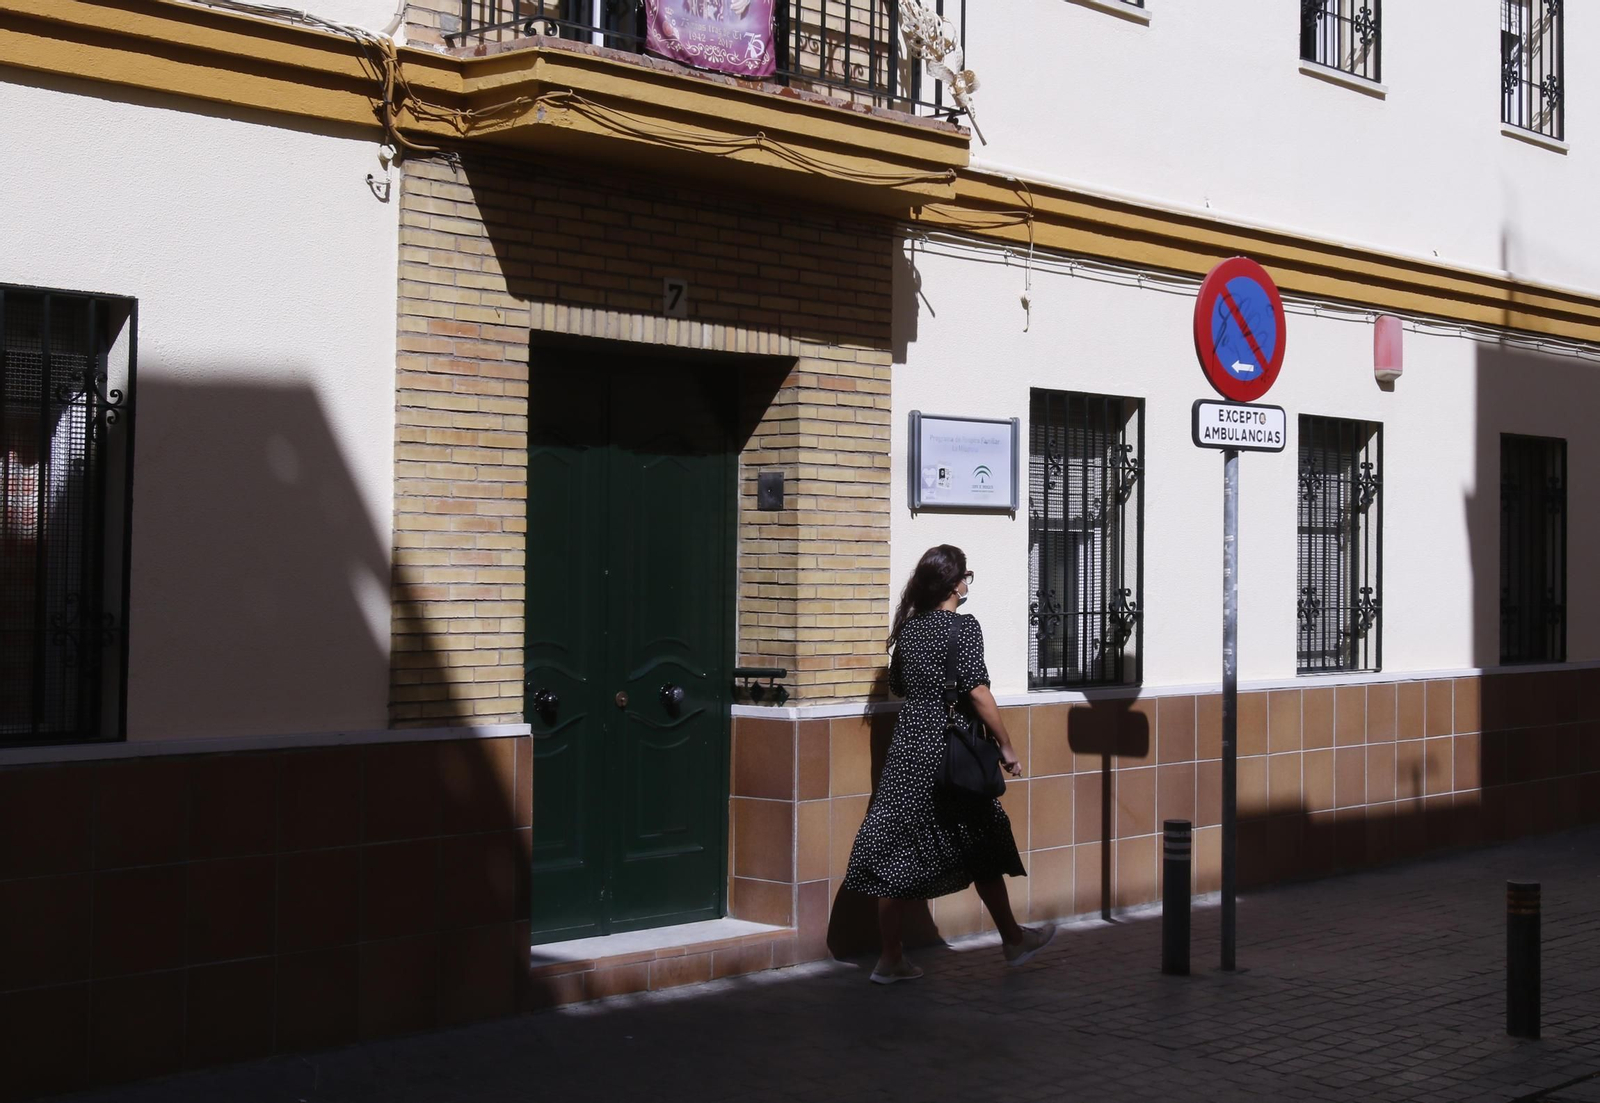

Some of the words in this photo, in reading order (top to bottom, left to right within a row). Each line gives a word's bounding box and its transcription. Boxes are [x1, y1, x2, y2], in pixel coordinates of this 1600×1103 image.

[689, 31, 706, 43] 1942
[717, 37, 734, 49] 2017
[743, 31, 765, 59] 75
[668, 283, 684, 311] 7
[1218, 408, 1267, 425] EXCEPTO
[1204, 426, 1281, 444] AMBULANCIAS
